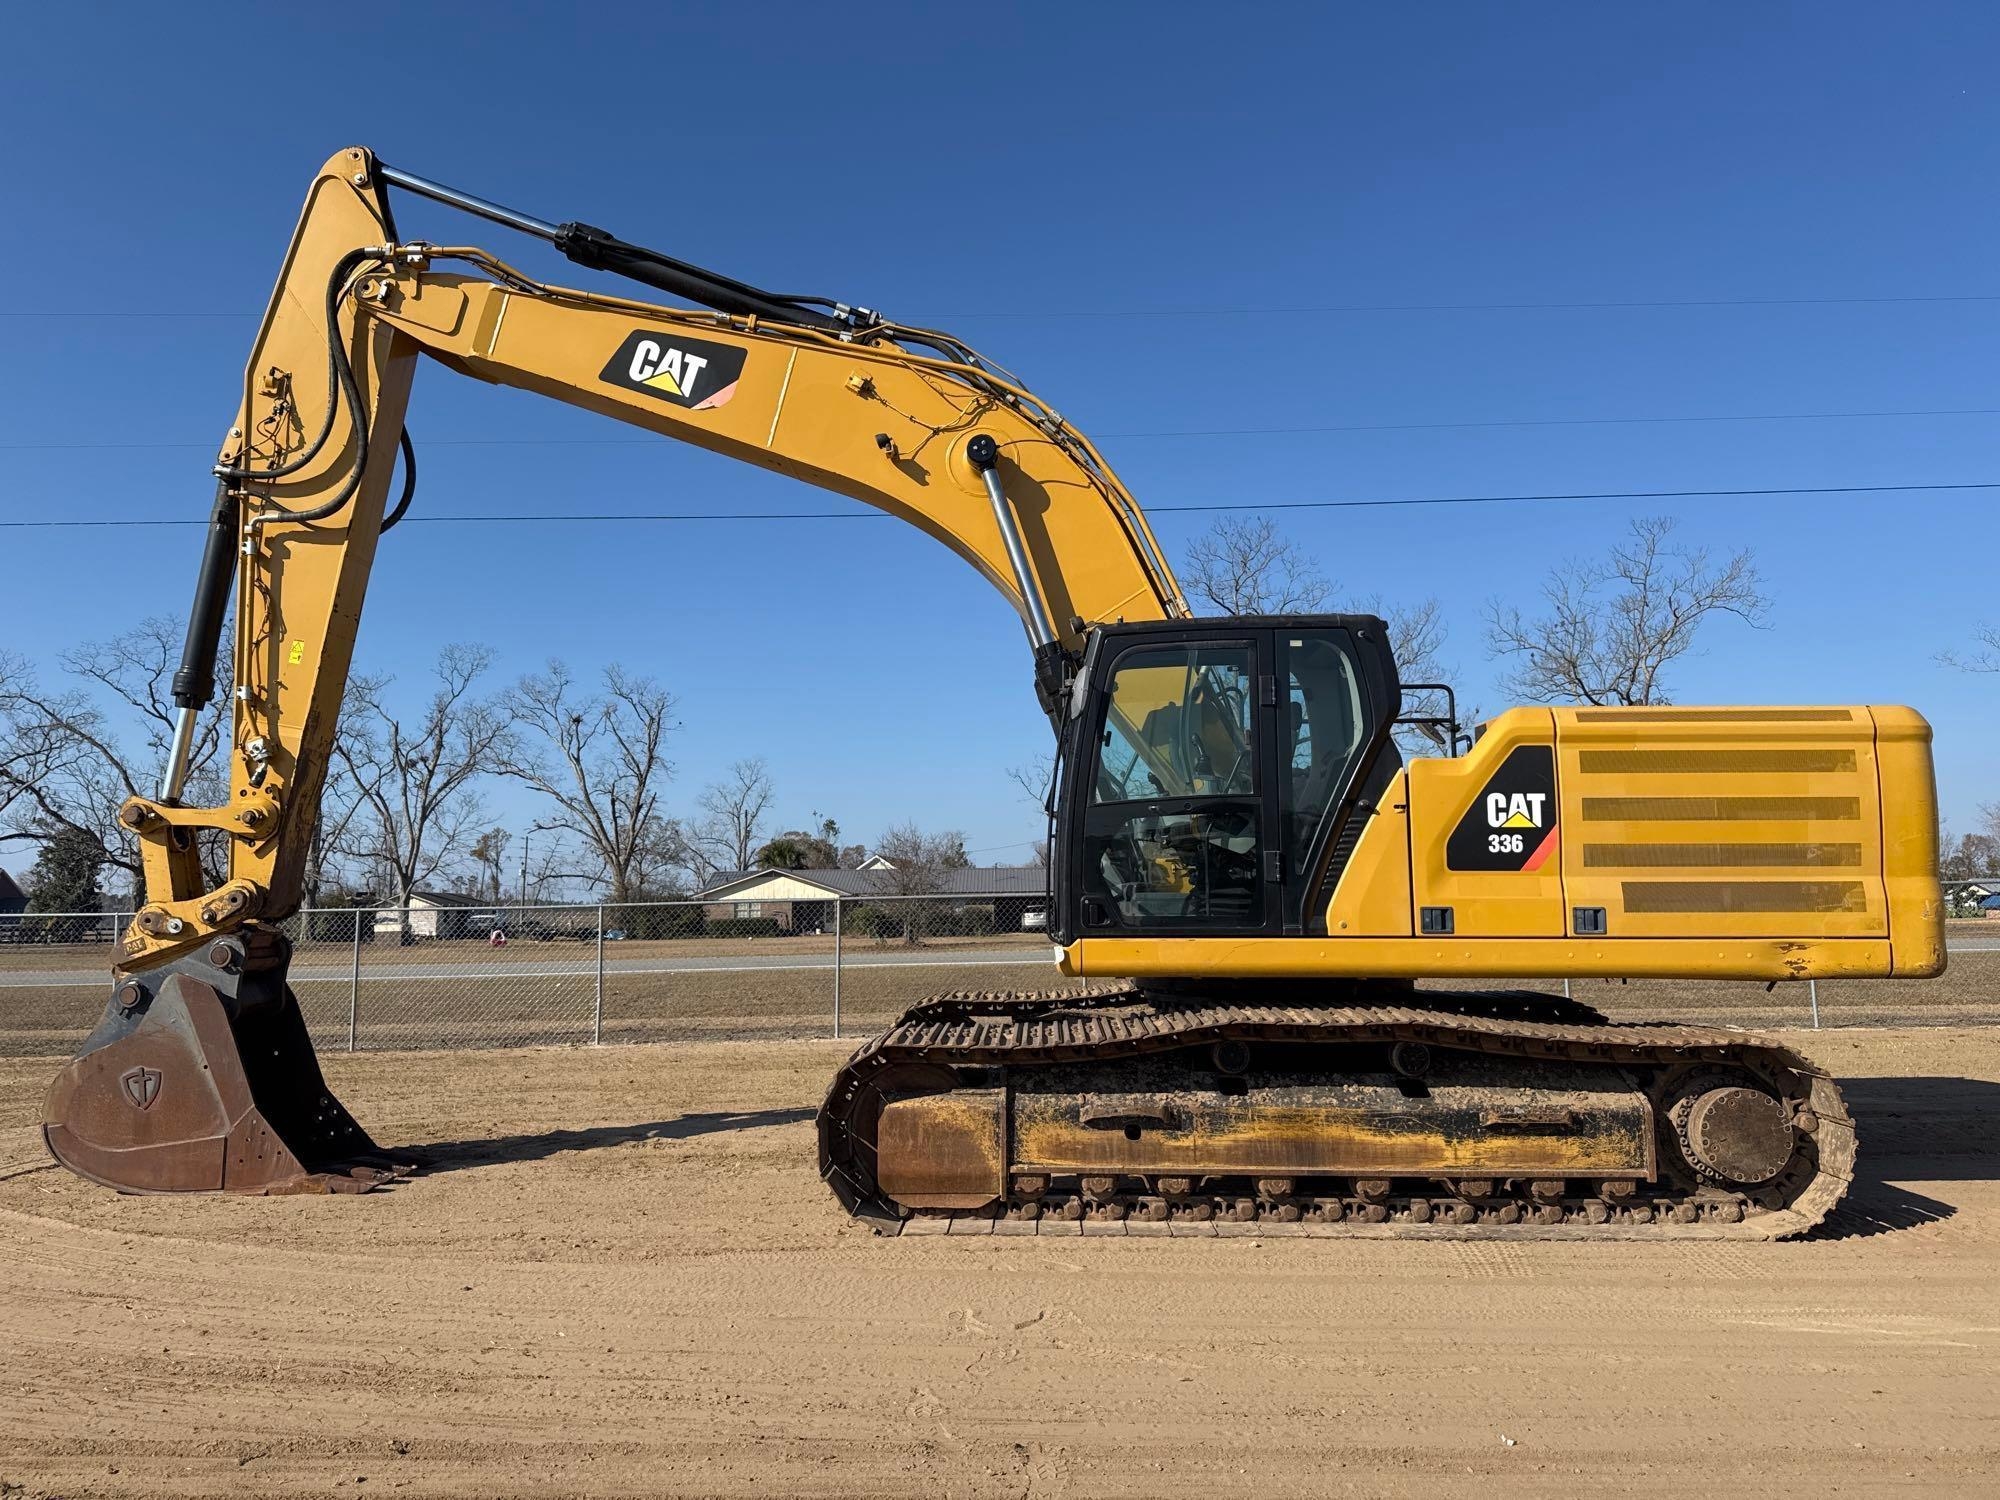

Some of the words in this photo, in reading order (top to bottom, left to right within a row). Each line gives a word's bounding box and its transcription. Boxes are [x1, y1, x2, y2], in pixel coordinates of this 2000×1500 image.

[628, 339, 708, 398] CAT
[1486, 792, 1546, 828] CAT
[1488, 834, 1524, 853] 336
